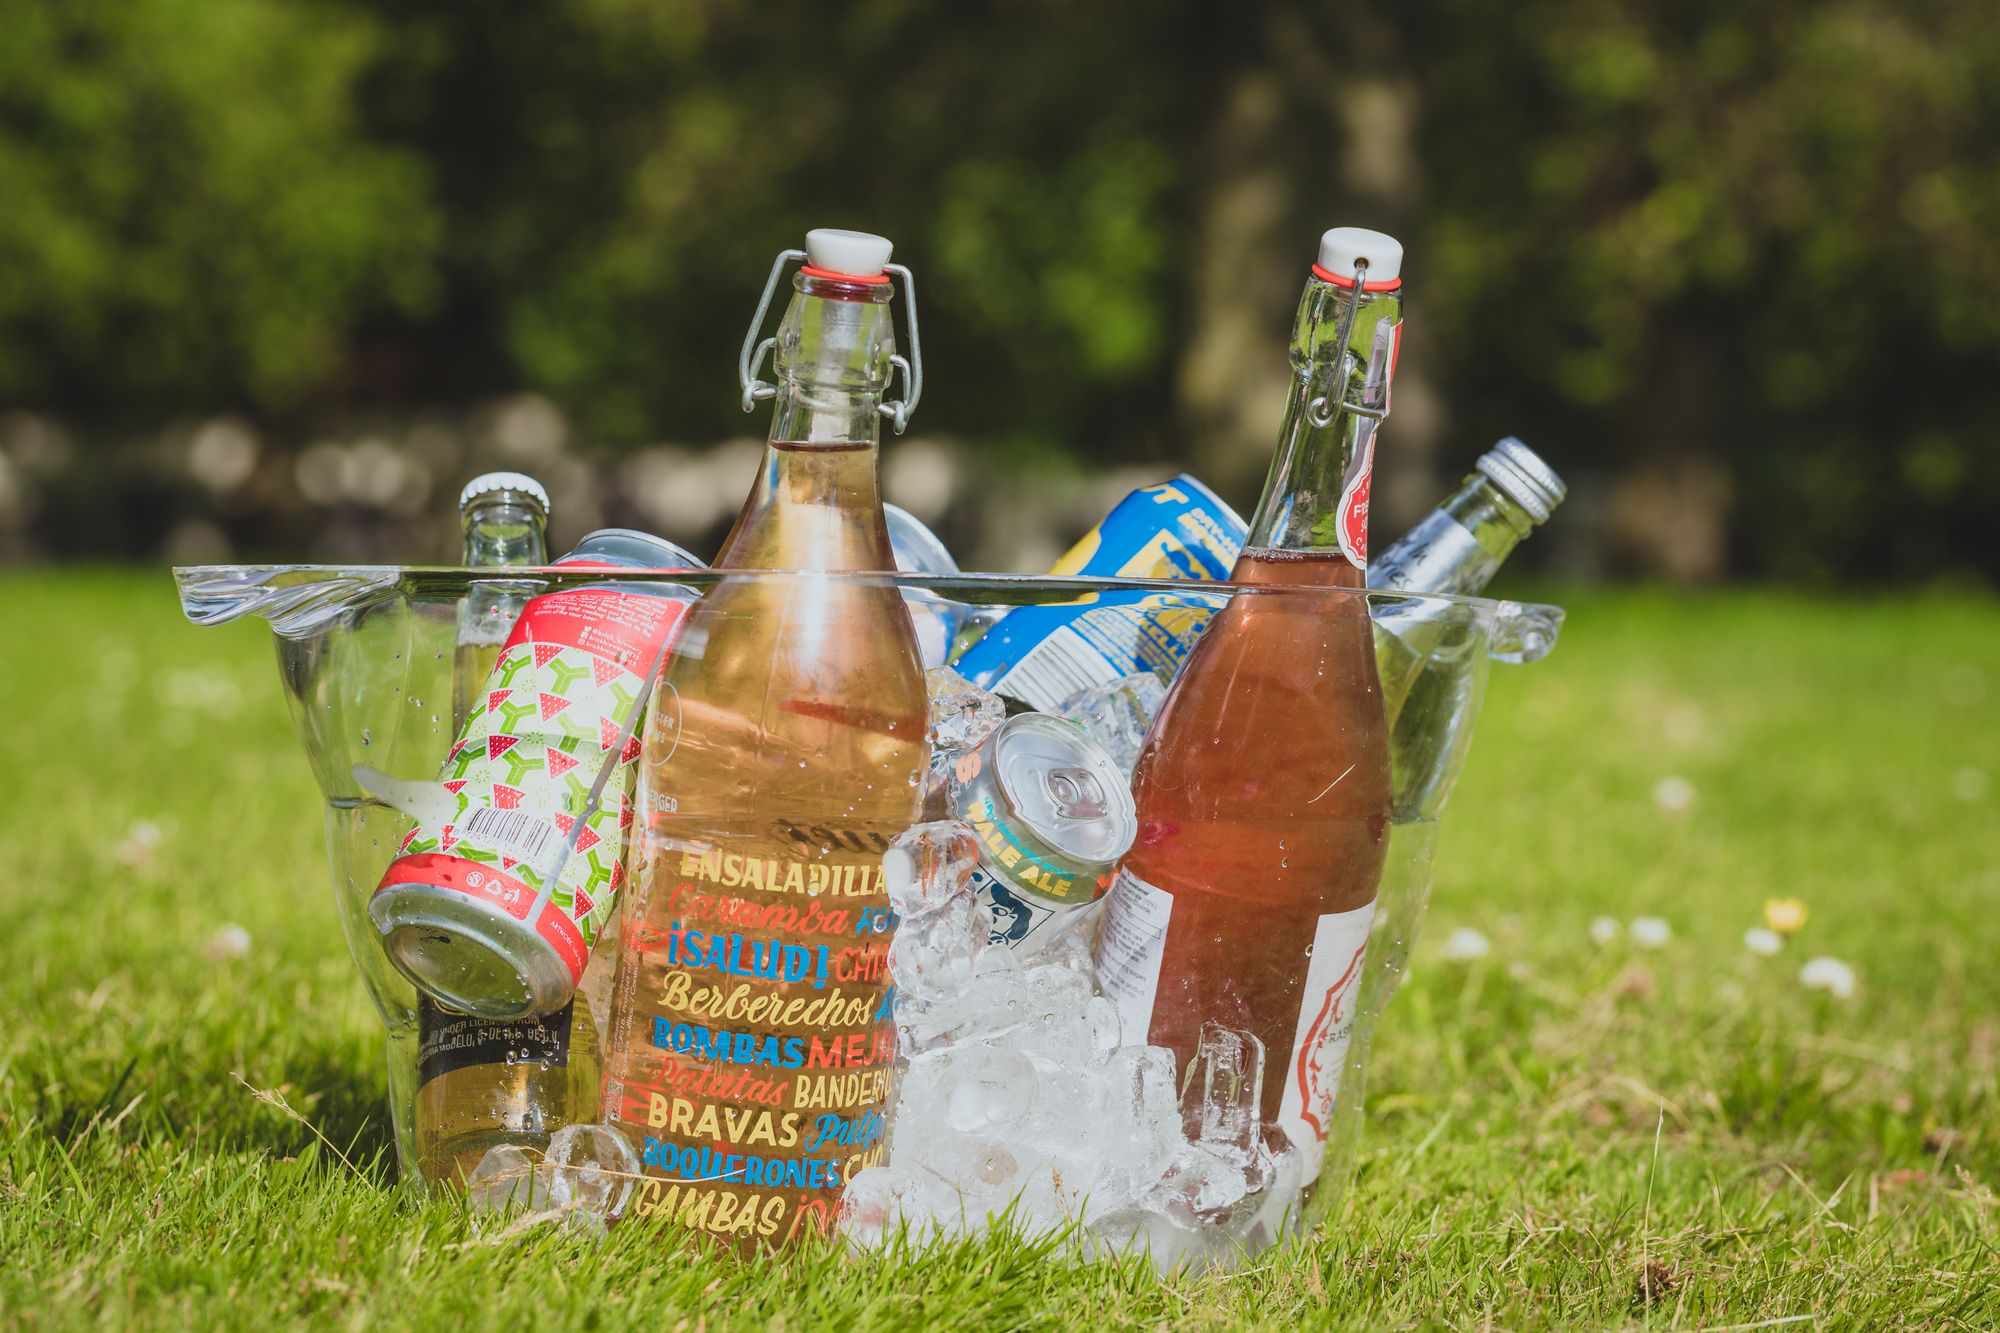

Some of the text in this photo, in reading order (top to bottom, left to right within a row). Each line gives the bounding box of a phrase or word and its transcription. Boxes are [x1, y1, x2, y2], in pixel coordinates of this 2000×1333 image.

[997, 821, 1043, 866] ENGLAND
[680, 848, 888, 897] ENSALADILLA
[1018, 864, 1073, 898] ALE
[550, 920, 574, 946] ARTWORK
[668, 881, 851, 935] Caramba
[657, 971, 876, 1027] Berberechos
[652, 1015, 805, 1069] BOMBAS
[650, 1056, 789, 1106] Patatas
[647, 1092, 800, 1148] BRAVAS
[643, 1134, 841, 1189] BOQUERONES
[635, 1179, 787, 1237] GAMBAS
